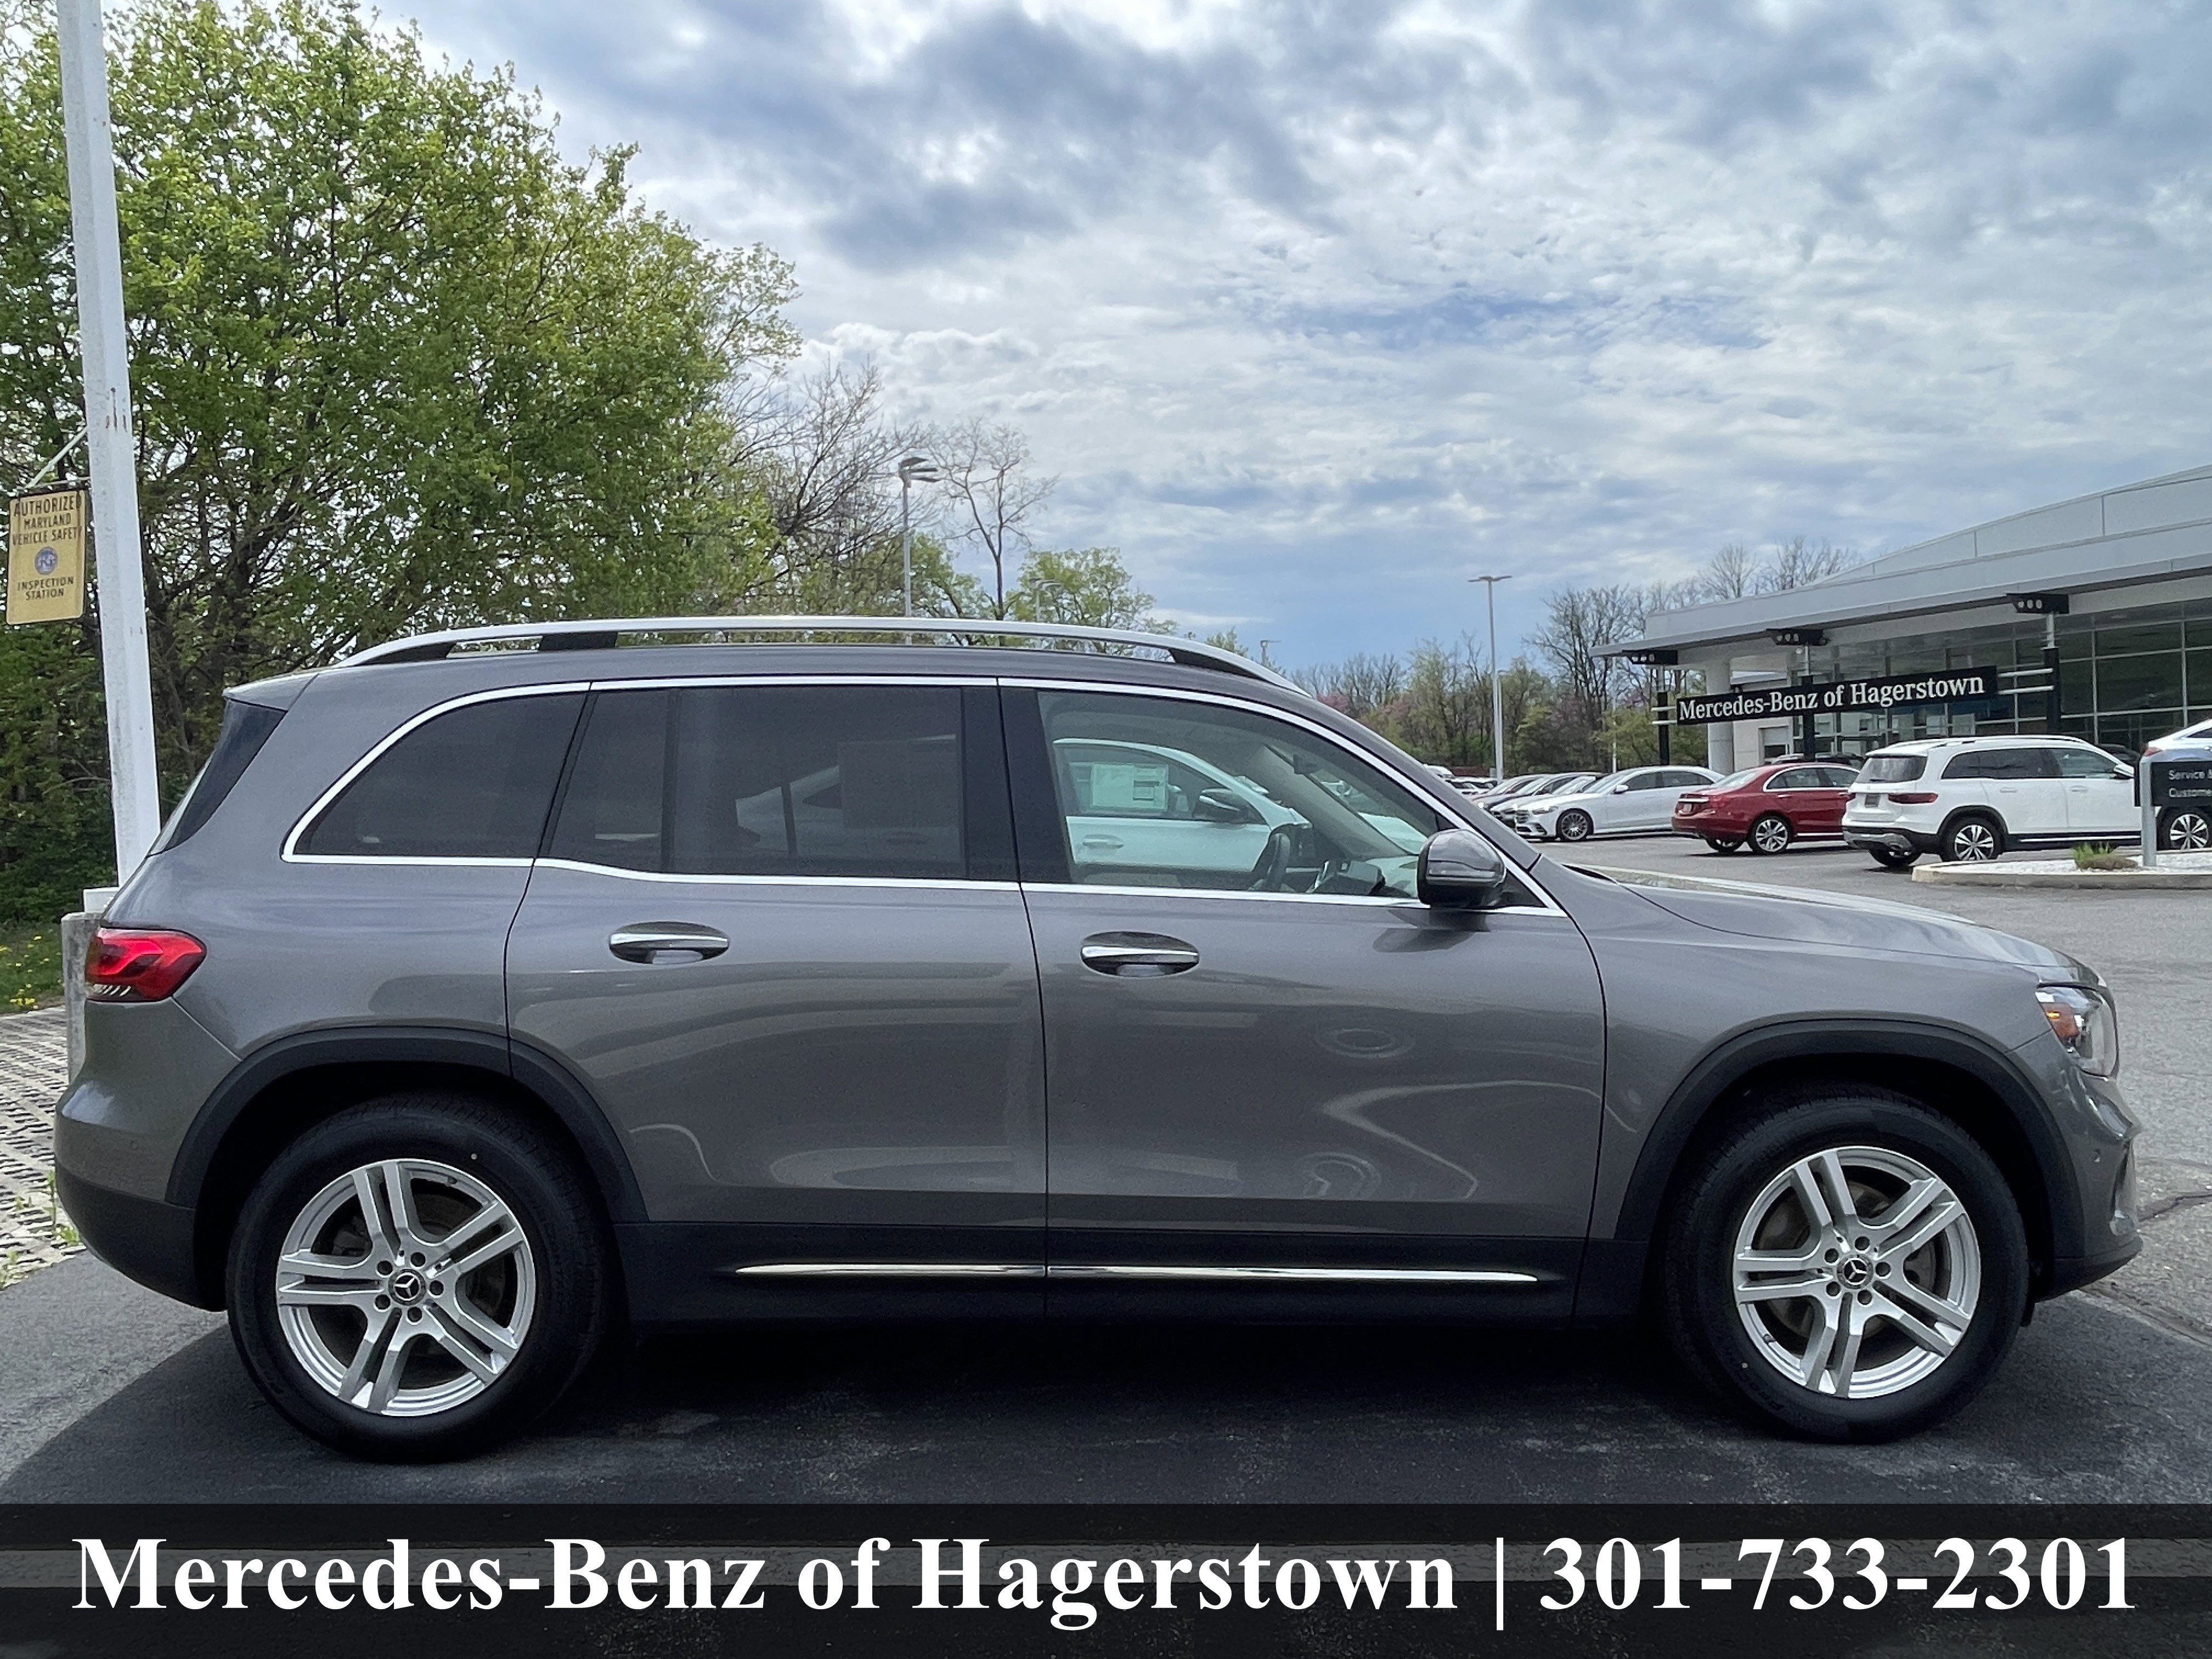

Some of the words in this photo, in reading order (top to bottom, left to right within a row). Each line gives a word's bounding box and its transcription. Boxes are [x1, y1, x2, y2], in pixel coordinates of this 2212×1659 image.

[24, 512, 71, 530] MARYLAND
[12, 530, 48, 545] VEHICLE
[51, 526, 82, 541] SAFETY
[17, 576, 75, 591] INSPECTION
[25, 588, 64, 601] STATION
[1678, 691, 1818, 721] Mercedes-Benz
[1824, 685, 1844, 707] of
[1850, 676, 1985, 707] Hagerstown
[2168, 769, 2205, 780] Service
